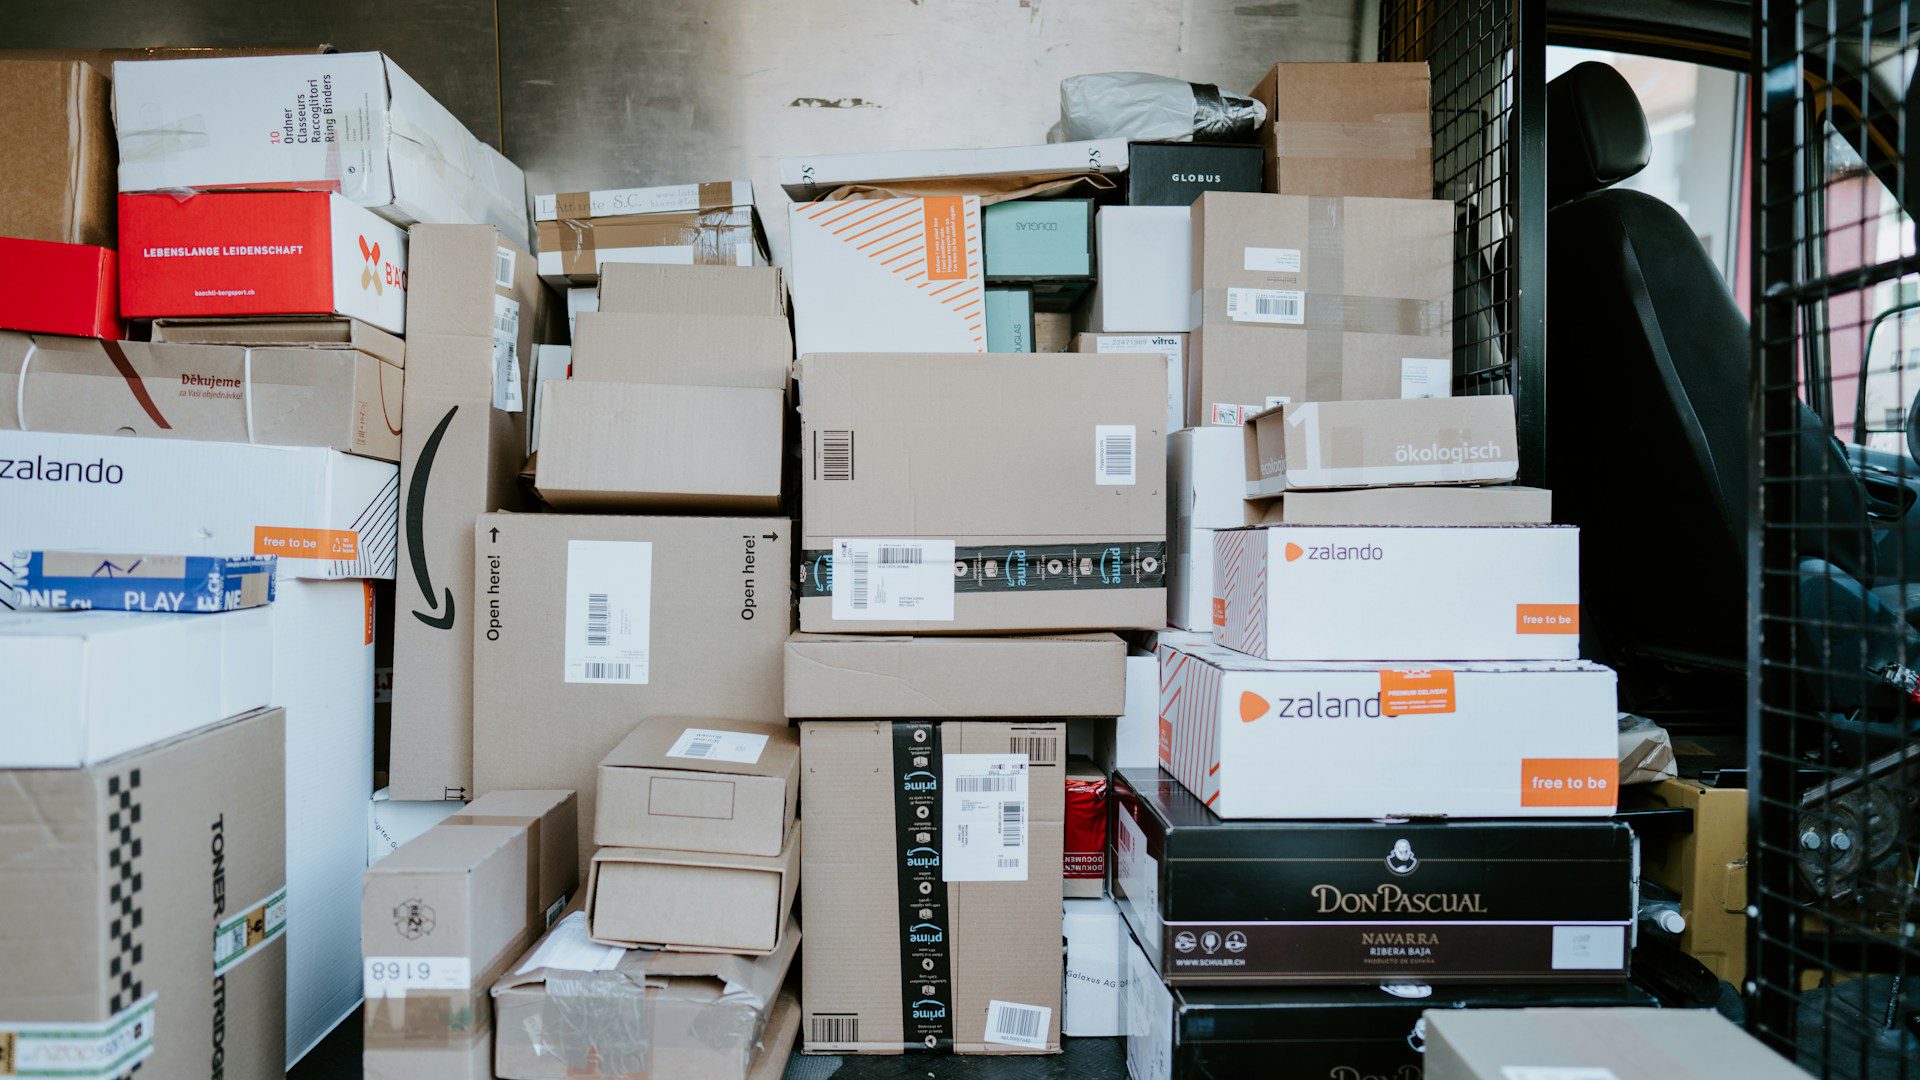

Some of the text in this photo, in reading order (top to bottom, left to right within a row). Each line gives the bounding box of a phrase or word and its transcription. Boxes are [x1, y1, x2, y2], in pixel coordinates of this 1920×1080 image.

[308, 79, 322, 143] Raccoglitori
[322, 74, 337, 143] Ring Binders
[283, 108, 294, 144] Ordner
[298, 94, 308, 144] Classeurs
[270, 131, 281, 145] 10
[1172, 173, 1221, 183] GLOBUS
[1015, 222, 1057, 231] DOUGLAS
[143, 245, 304, 258] LEBENSLANGE LEIDENSCHAFT
[1151, 336, 1177, 345] vitra.
[181, 373, 241, 389] Děkujeme
[1395, 440, 1501, 465] ökologisch
[0, 454, 124, 485] zalando
[263, 536, 317, 549] free to be
[1308, 542, 1384, 561] zalando
[1015, 550, 1028, 586] prime
[1109, 547, 1123, 584] prime
[741, 534, 757, 621] Open here!
[124, 591, 186, 612] PLAY
[486, 554, 502, 641] Open here!
[1522, 614, 1572, 625] free to be
[1279, 692, 1398, 718] zaland
[904, 779, 937, 792] prime
[1531, 776, 1607, 789] free to be
[210, 813, 226, 919] TONER
[907, 855, 940, 868] prime
[910, 931, 943, 944] prime
[1361, 933, 1440, 945] NAVARRA
[1369, 947, 1432, 957] RIBERA BAJA
[1175, 958, 1246, 967] WWW.SCHULER.CH
[1066, 970, 1101, 985] Galaxus
[1103, 979, 1117, 988] AG
[912, 1006, 945, 1020] prime
